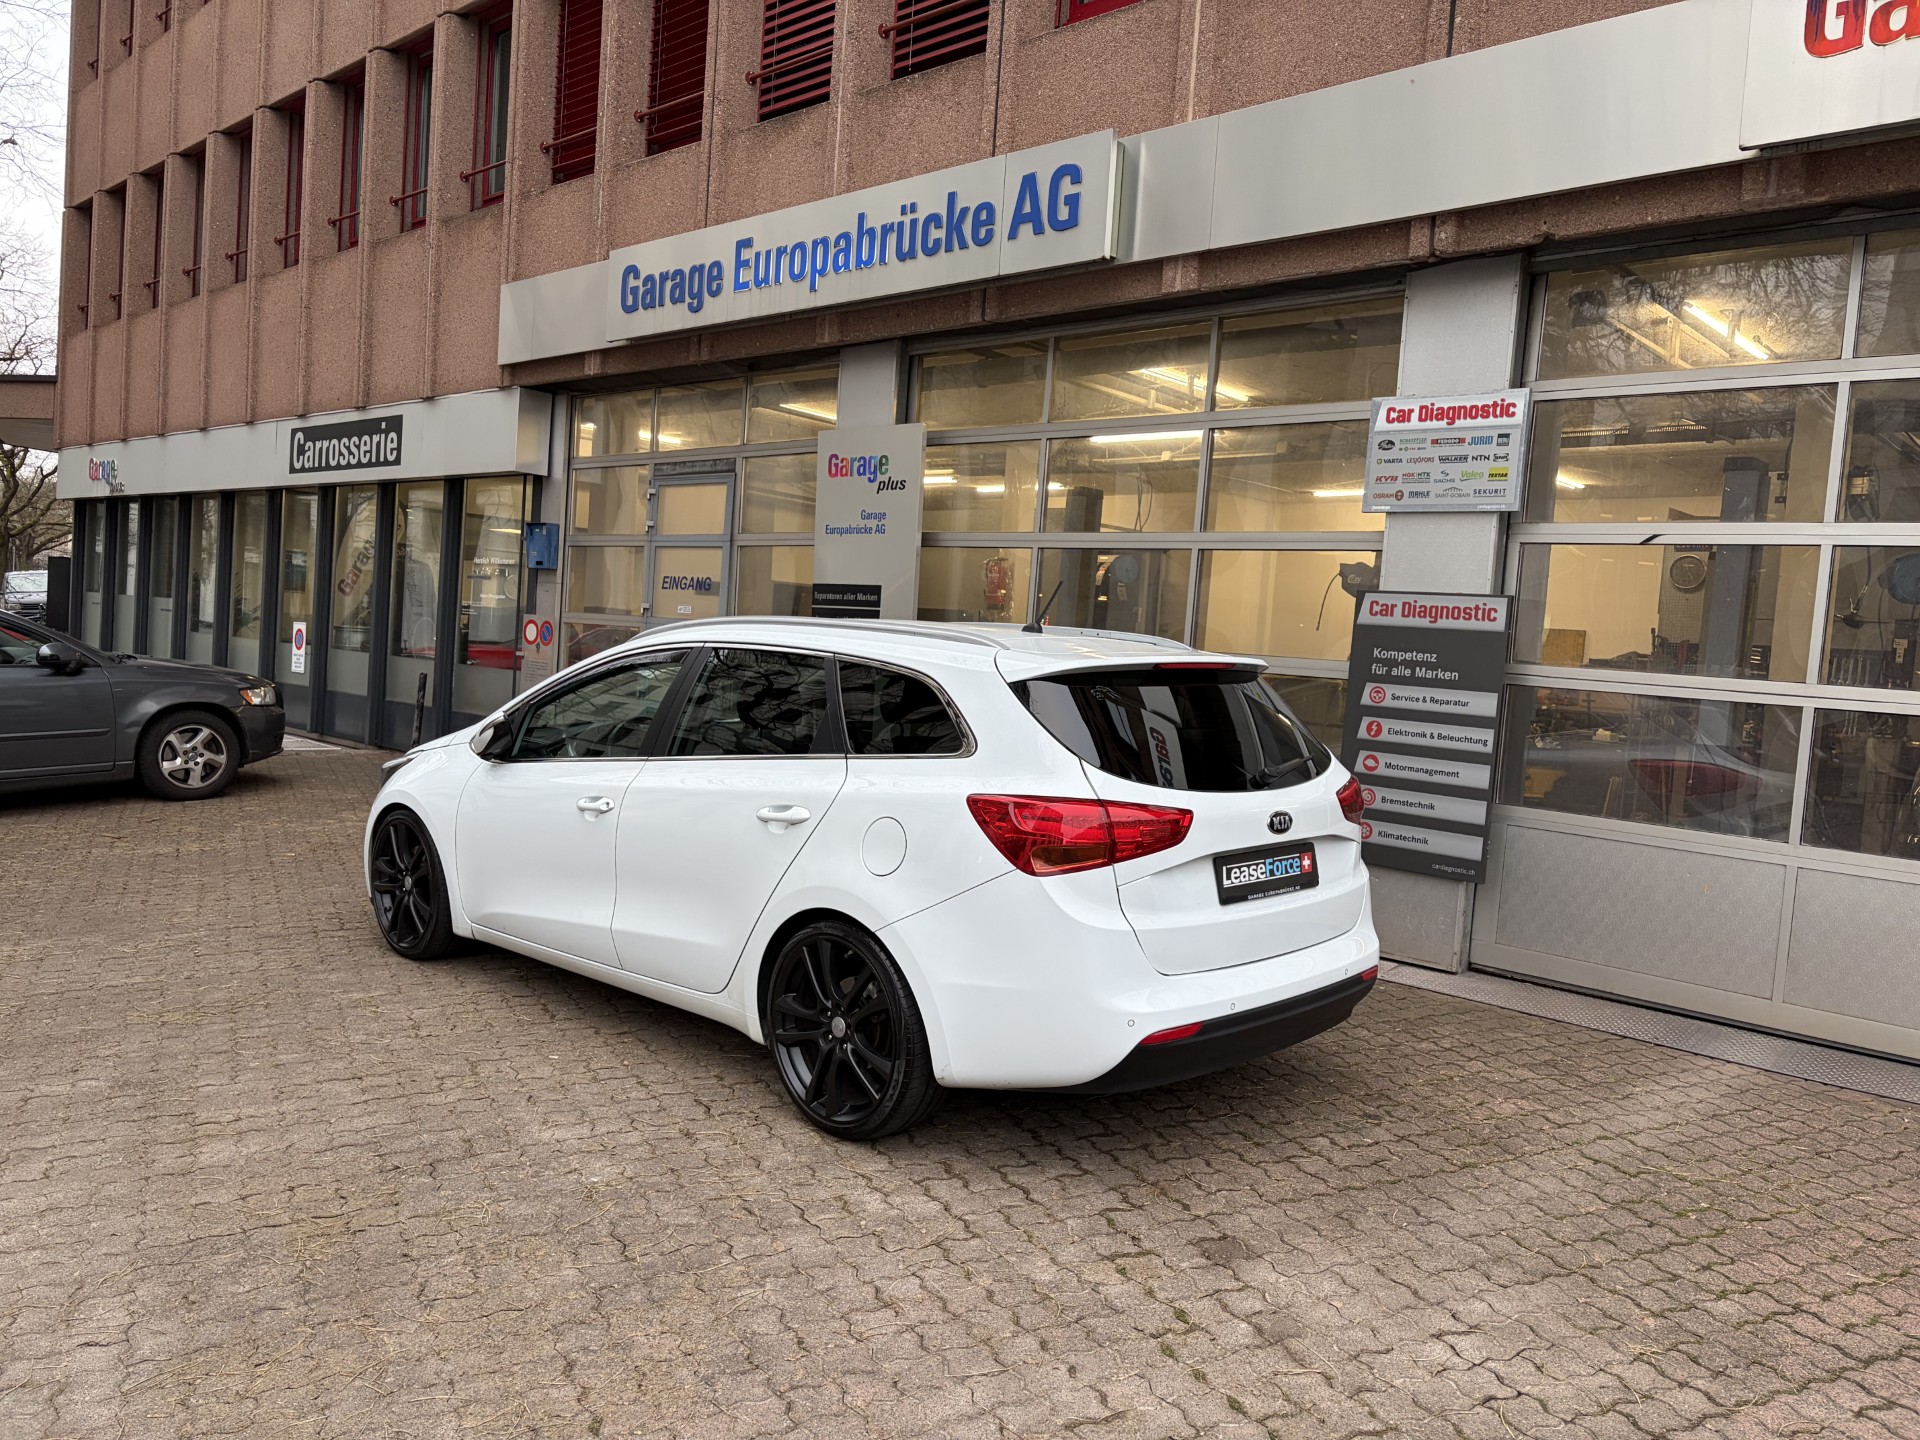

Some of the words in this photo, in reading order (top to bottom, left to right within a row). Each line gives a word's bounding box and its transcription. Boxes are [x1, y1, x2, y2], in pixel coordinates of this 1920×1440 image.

[620, 259, 724, 314] Garage
[733, 190, 996, 293] Europabrücke
[1008, 163, 1083, 240] AG
[1385, 406, 1415, 424] Car
[1417, 398, 1517, 426] Diagnostic
[293, 421, 398, 470] Carrosserie
[1468, 435, 1494, 446] JURID
[1438, 455, 1469, 463] WALKER
[1472, 454, 1490, 462] NTN
[89, 457, 118, 486] Garage
[828, 453, 889, 484] Garage
[1460, 470, 1484, 479] Valeo
[876, 476, 907, 495] plus
[860, 509, 887, 523] Garage
[825, 523, 873, 537] Europabrücke
[874, 523, 886, 535] AG
[661, 575, 712, 591] EINGANG
[856, 592, 878, 602] Marken
[1368, 600, 1398, 617] Car
[1401, 599, 1498, 624] Diagnostic
[1372, 647, 1438, 663] Kompetenz
[1371, 663, 1388, 675] für
[1391, 665, 1412, 677] alle
[1415, 666, 1459, 681] Marken
[1390, 693, 1420, 703] Service
[1421, 696, 1427, 704] &
[1429, 696, 1470, 708] Reparatur
[1387, 727, 1428, 739] Elektronik
[1429, 731, 1435, 739] &
[1437, 732, 1488, 747] Beleuchtung
[1384, 761, 1460, 778] Motormanagement
[1381, 795, 1436, 811] Bremstechnik
[1377, 829, 1429, 845] Klimatechnik
[1222, 857, 1301, 886] LeaseForce
